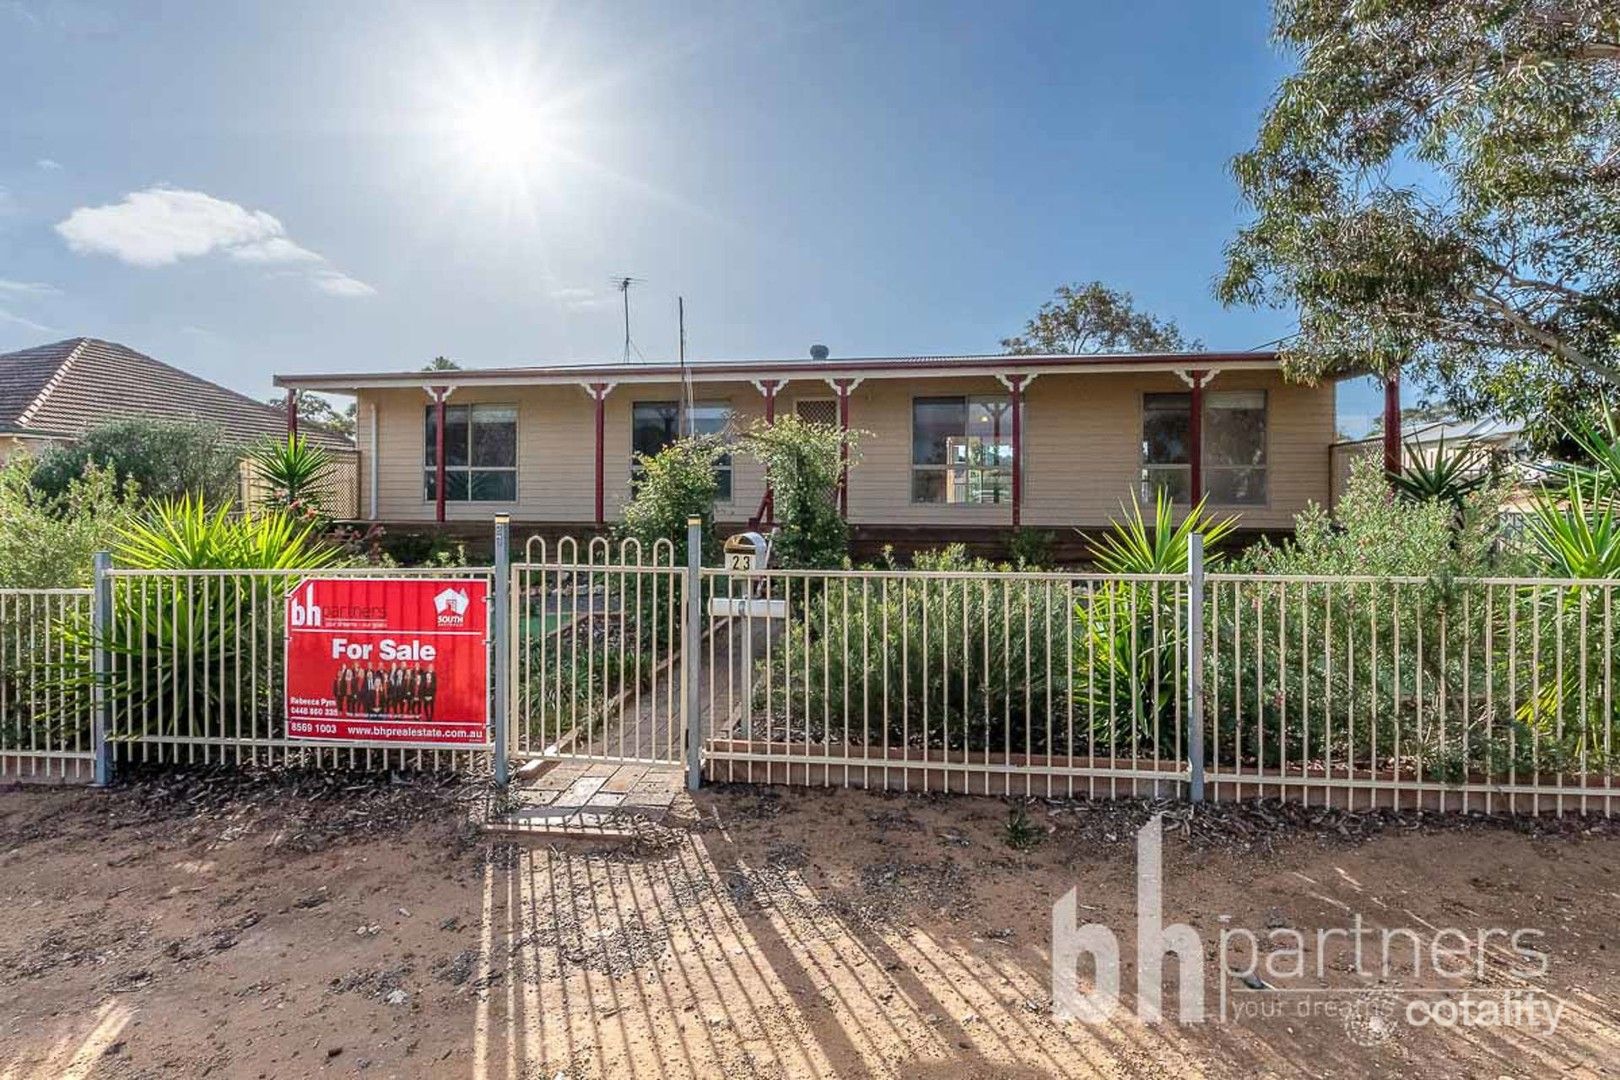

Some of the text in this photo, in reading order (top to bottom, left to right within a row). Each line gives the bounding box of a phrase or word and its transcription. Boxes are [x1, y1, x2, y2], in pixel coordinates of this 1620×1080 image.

[733, 555, 750, 570] 23
[291, 583, 321, 627] bh
[437, 615, 464, 623] SOUTH
[332, 638, 437, 661] For Sale
[291, 722, 337, 734] 8569 1003
[347, 724, 483, 739] www.bhprealestate.com.au
